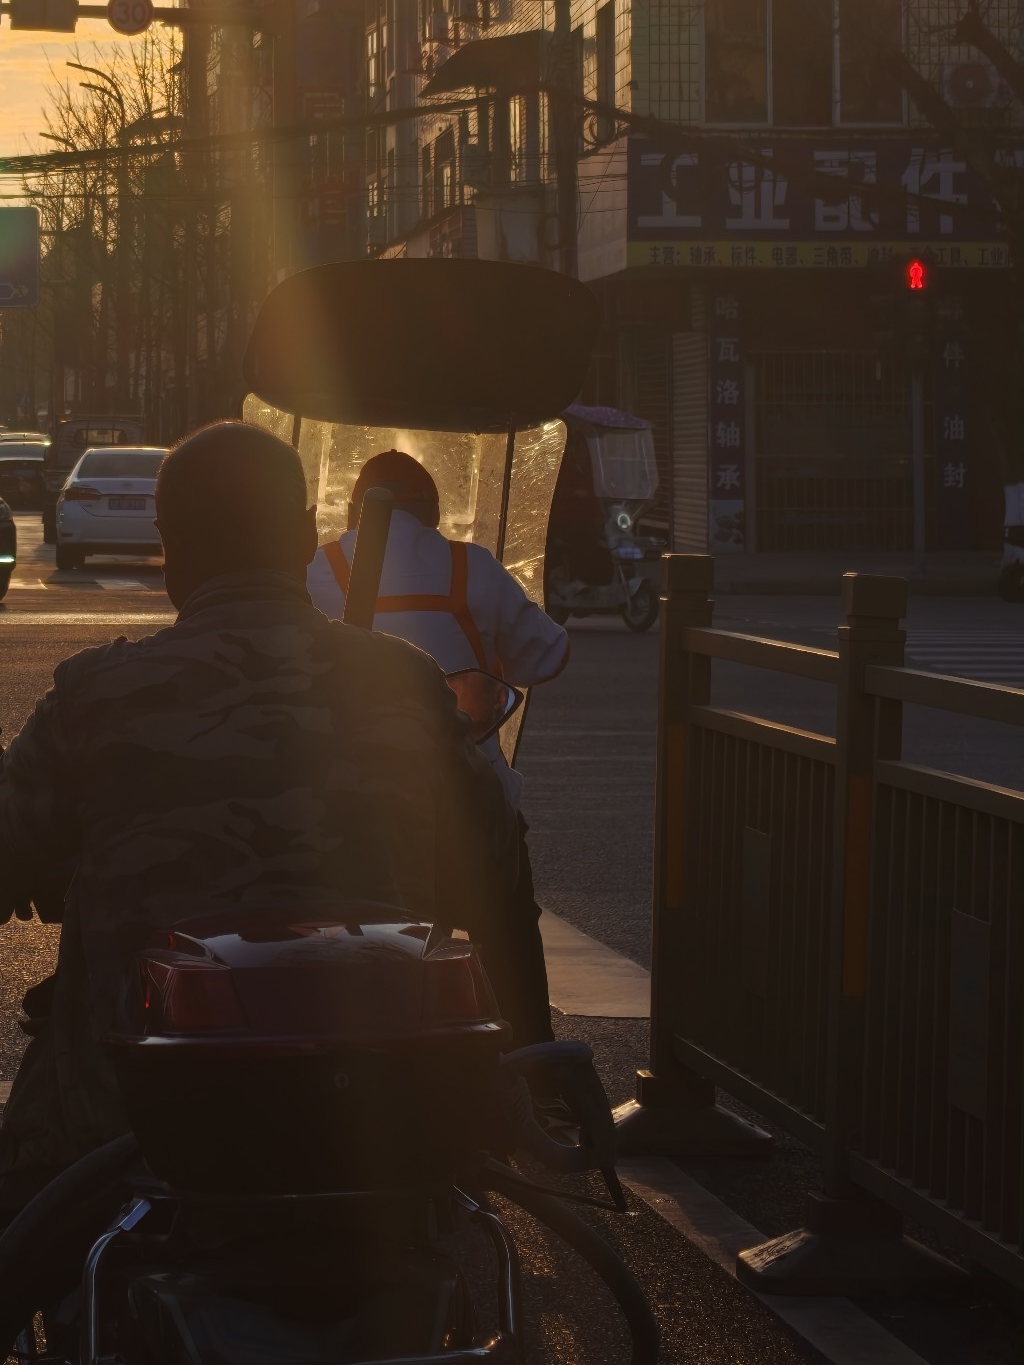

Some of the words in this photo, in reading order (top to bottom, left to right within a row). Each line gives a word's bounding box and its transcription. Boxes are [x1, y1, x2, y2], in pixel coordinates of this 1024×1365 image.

[115, 1, 147, 25] 30
[714, 295, 741, 491] 哈瓦洛轴承
